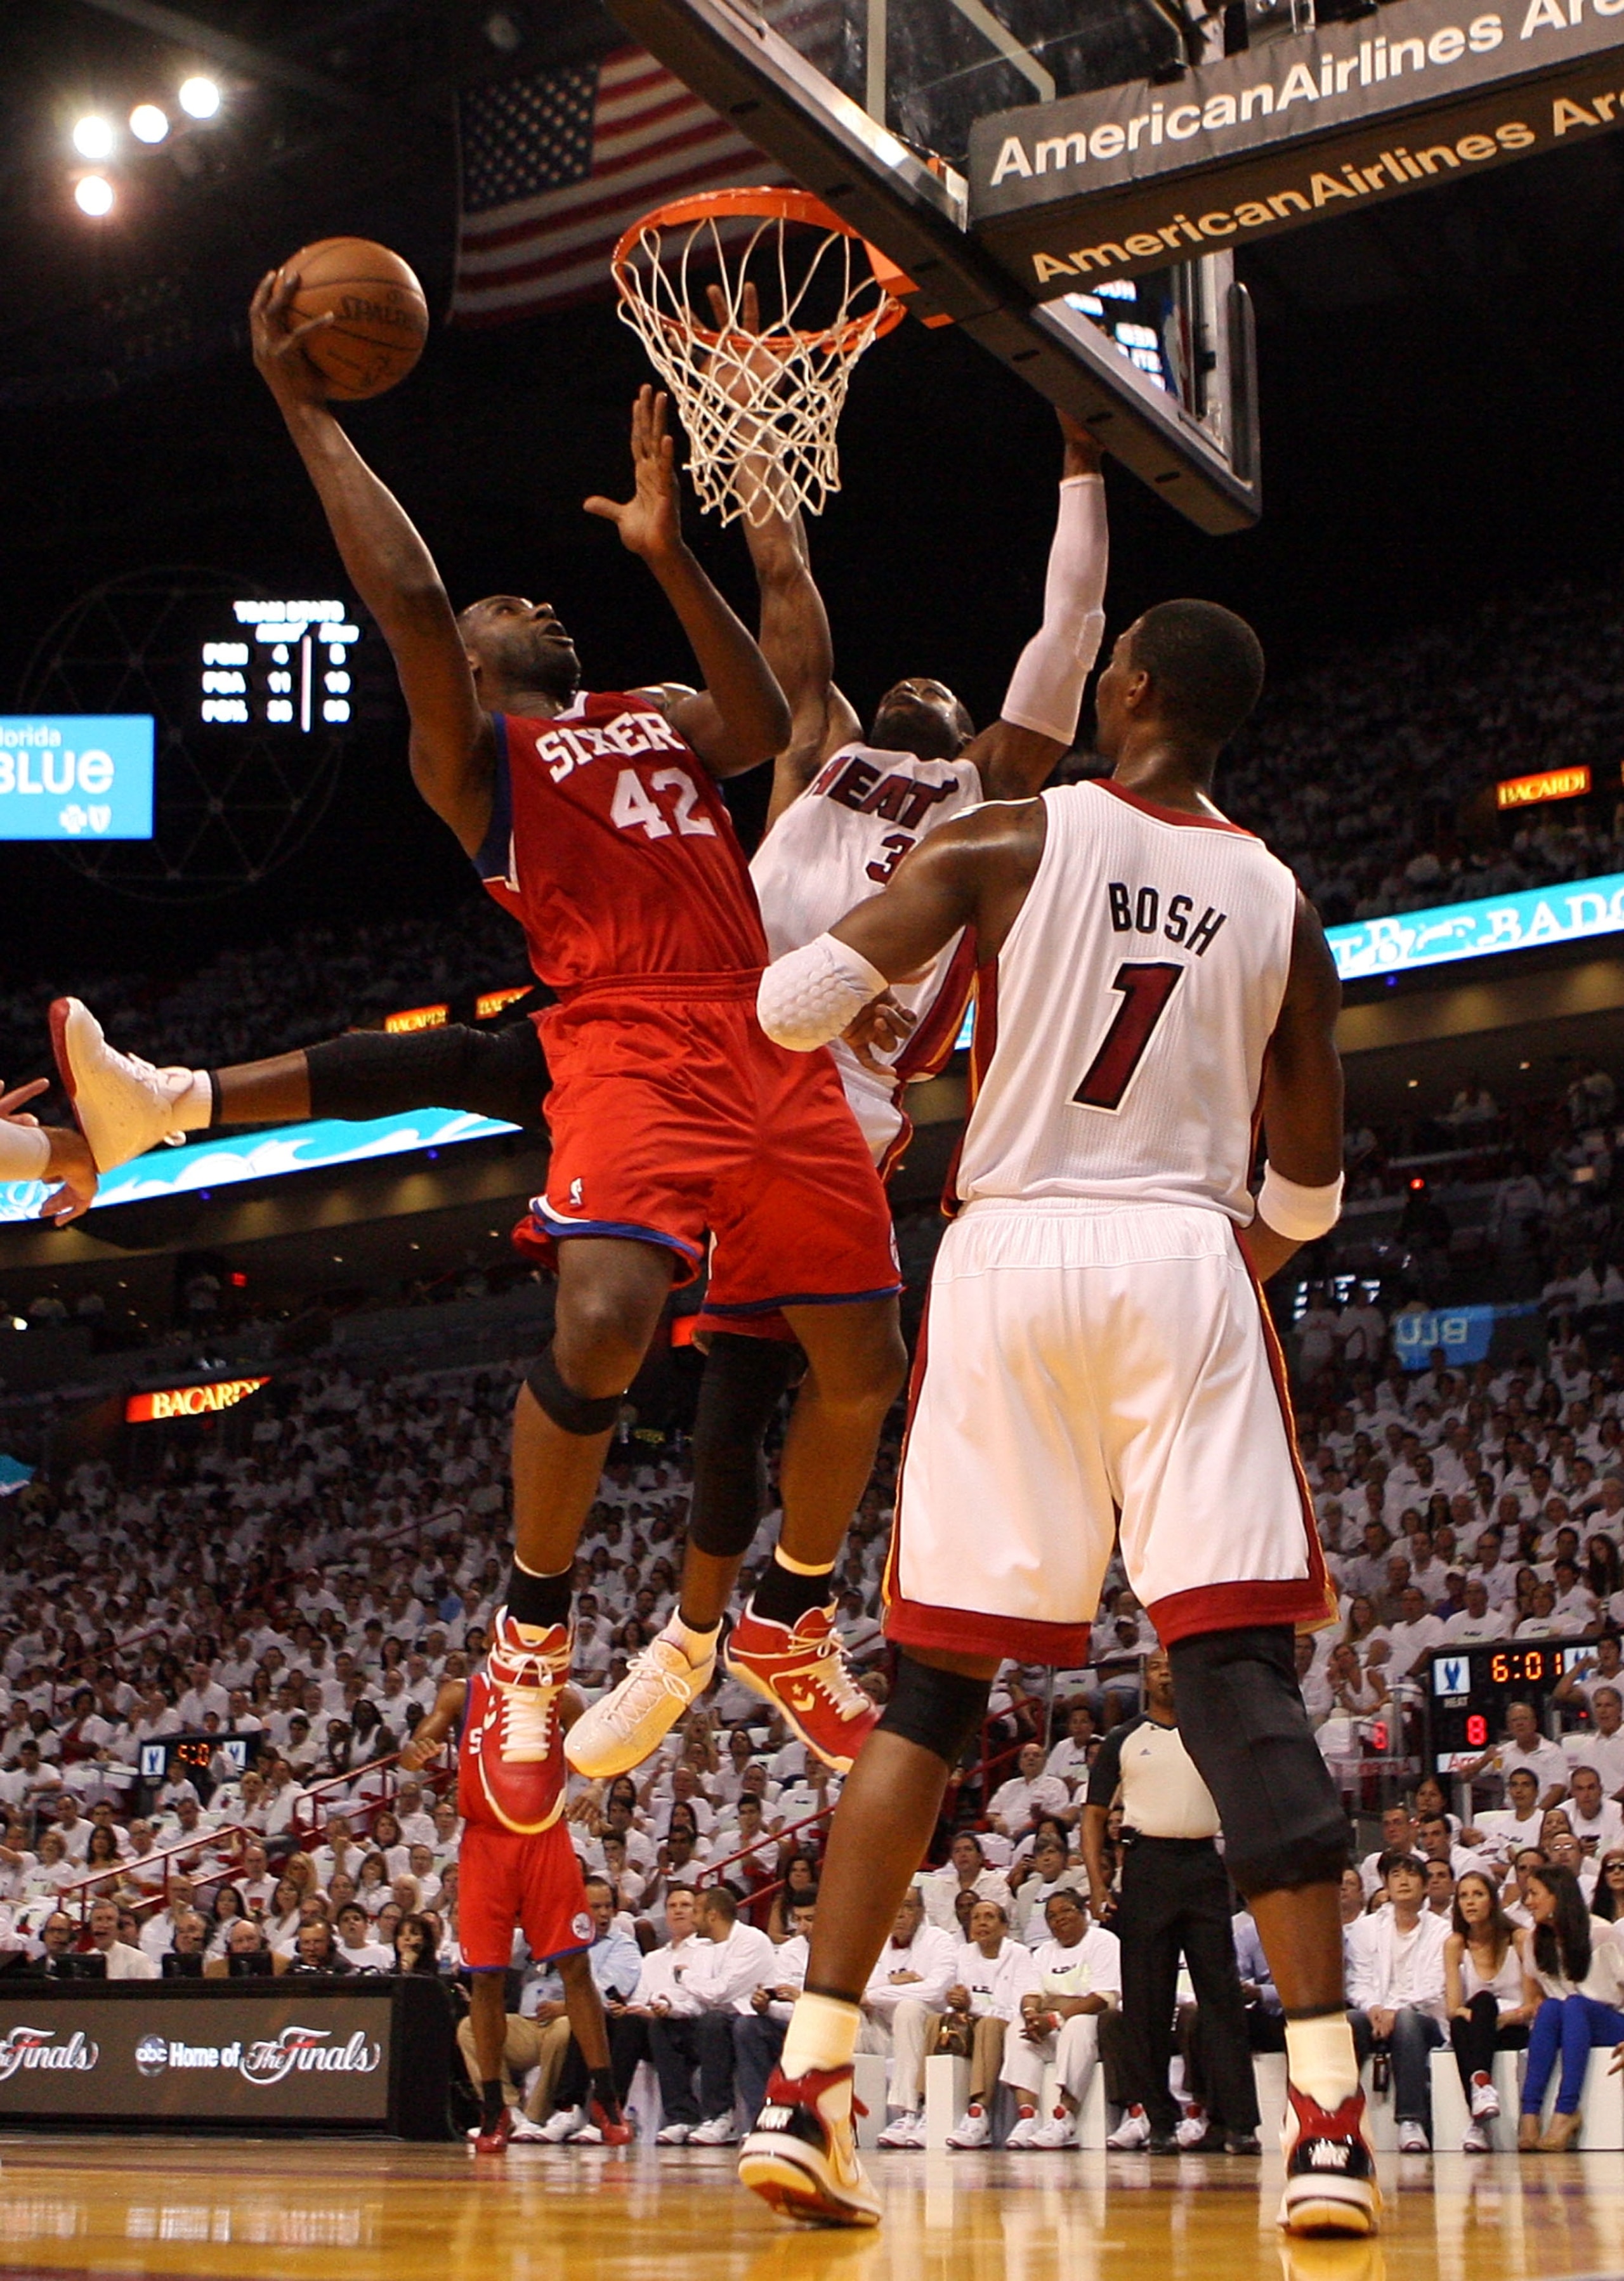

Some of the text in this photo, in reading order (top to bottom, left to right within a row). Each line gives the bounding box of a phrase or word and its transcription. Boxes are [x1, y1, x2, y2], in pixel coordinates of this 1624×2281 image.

[990, 13, 1504, 186] AmericanAirlines
[1032, 90, 1624, 283] AmericanAirlines Ar
[610, 767, 717, 840] 42
[1499, 771, 1585, 806] BACARDI
[865, 833, 917, 886] 3
[1108, 882, 1228, 957] BOSH
[1069, 959, 1186, 1113] 1
[1493, 1651, 1562, 1682] 6:01
[1465, 1715, 1488, 1746] 8
[0, 2027, 99, 2081] Finals
[135, 2027, 381, 2085] abc Home of The Finals
